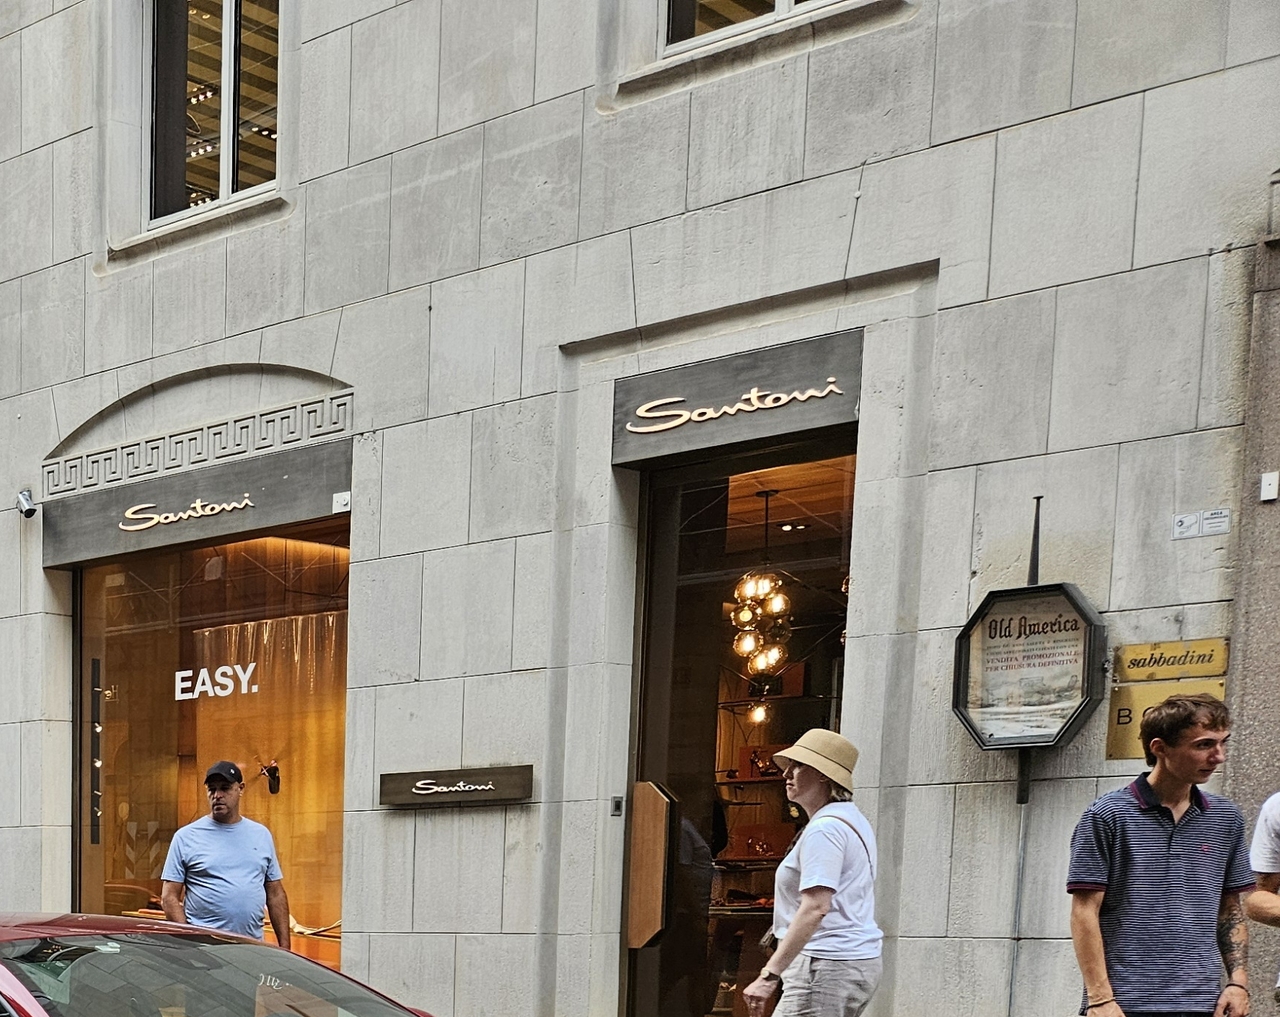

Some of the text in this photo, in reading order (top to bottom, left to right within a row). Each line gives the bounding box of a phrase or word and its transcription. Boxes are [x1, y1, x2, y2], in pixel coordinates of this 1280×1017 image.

[625, 376, 844, 433] Santoni
[118, 492, 255, 531] Santoni
[988, 612, 1080, 640] Old America
[985, 656, 1019, 664] VENDITA
[1001, 661, 1036, 671] CHIUSURA
[1038, 658, 1079, 668] DEFINITIVA
[1127, 649, 1215, 670] sabbadini
[174, 662, 259, 701] EASY.
[411, 780, 496, 795] Santoni
